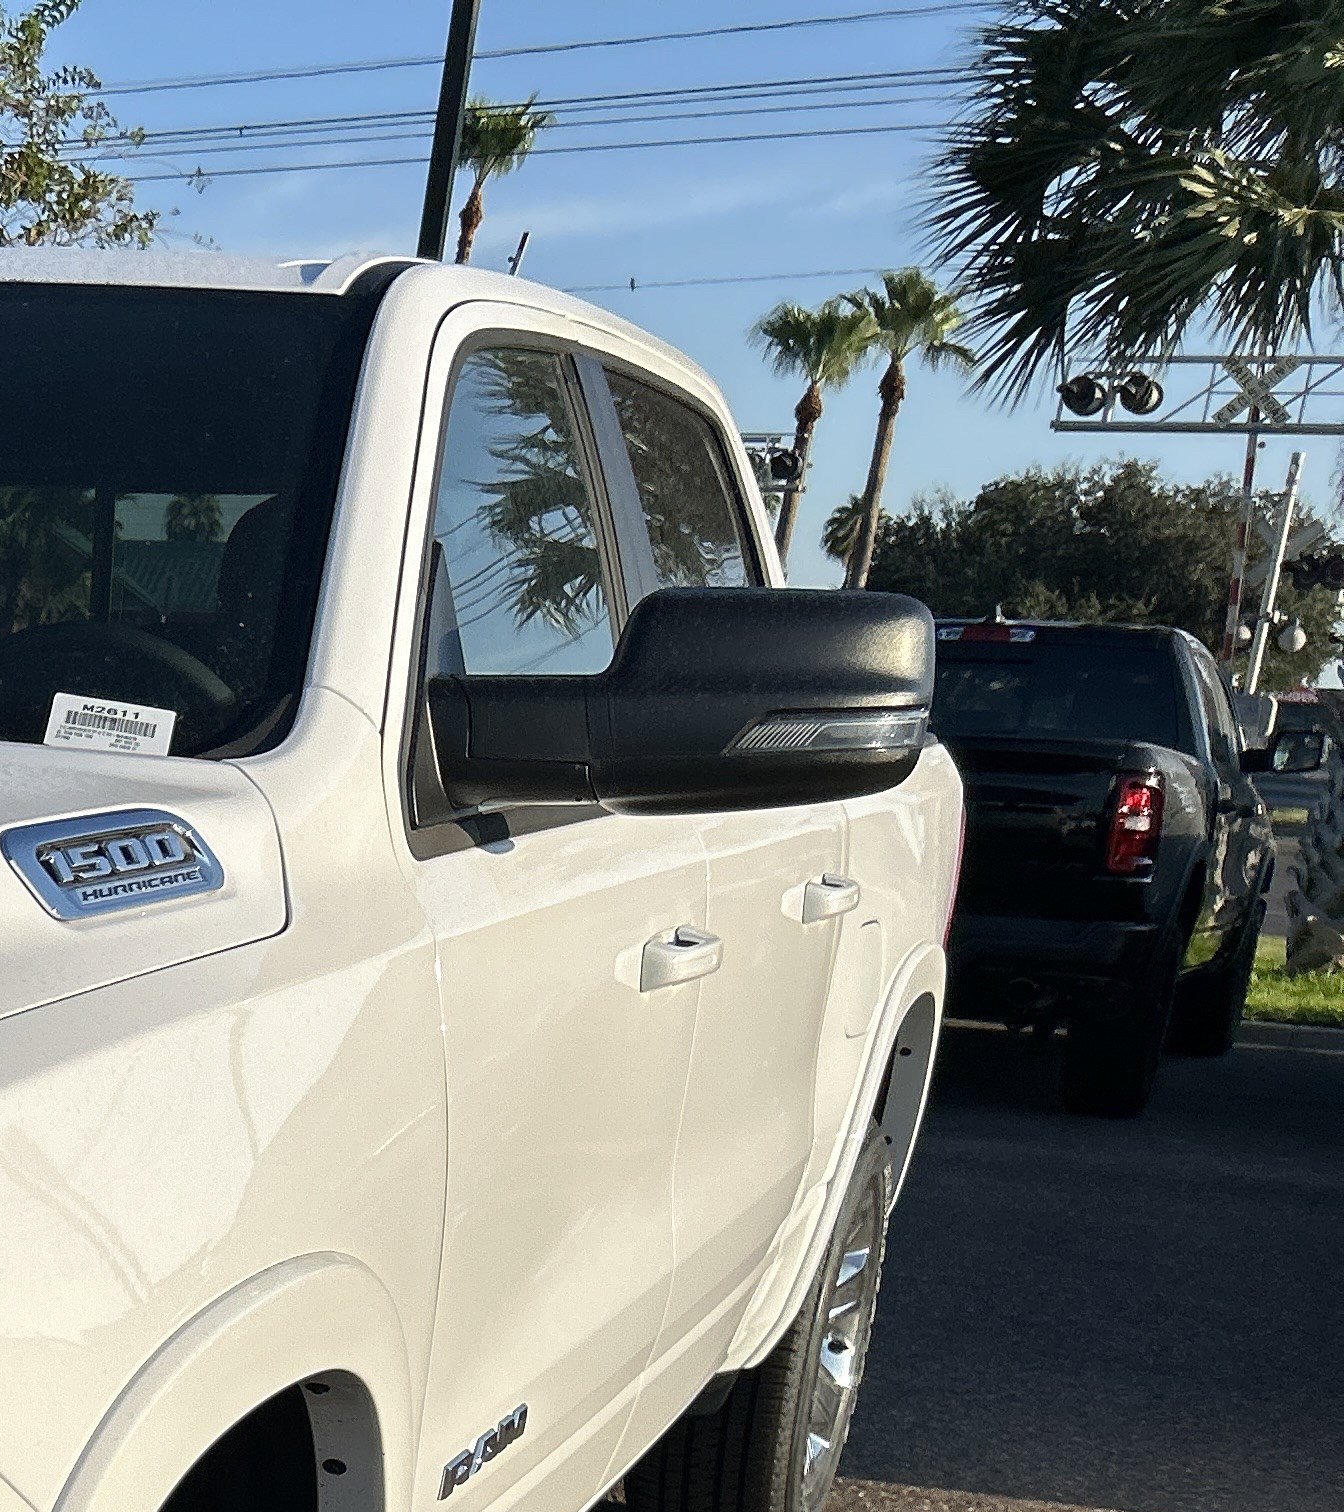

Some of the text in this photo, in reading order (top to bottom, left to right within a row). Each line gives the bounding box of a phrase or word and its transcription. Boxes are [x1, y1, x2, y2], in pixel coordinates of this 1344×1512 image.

[40, 832, 188, 884] 1500
[82, 869, 200, 901] HURRICANE
[437, 1402, 528, 1500] RAM
